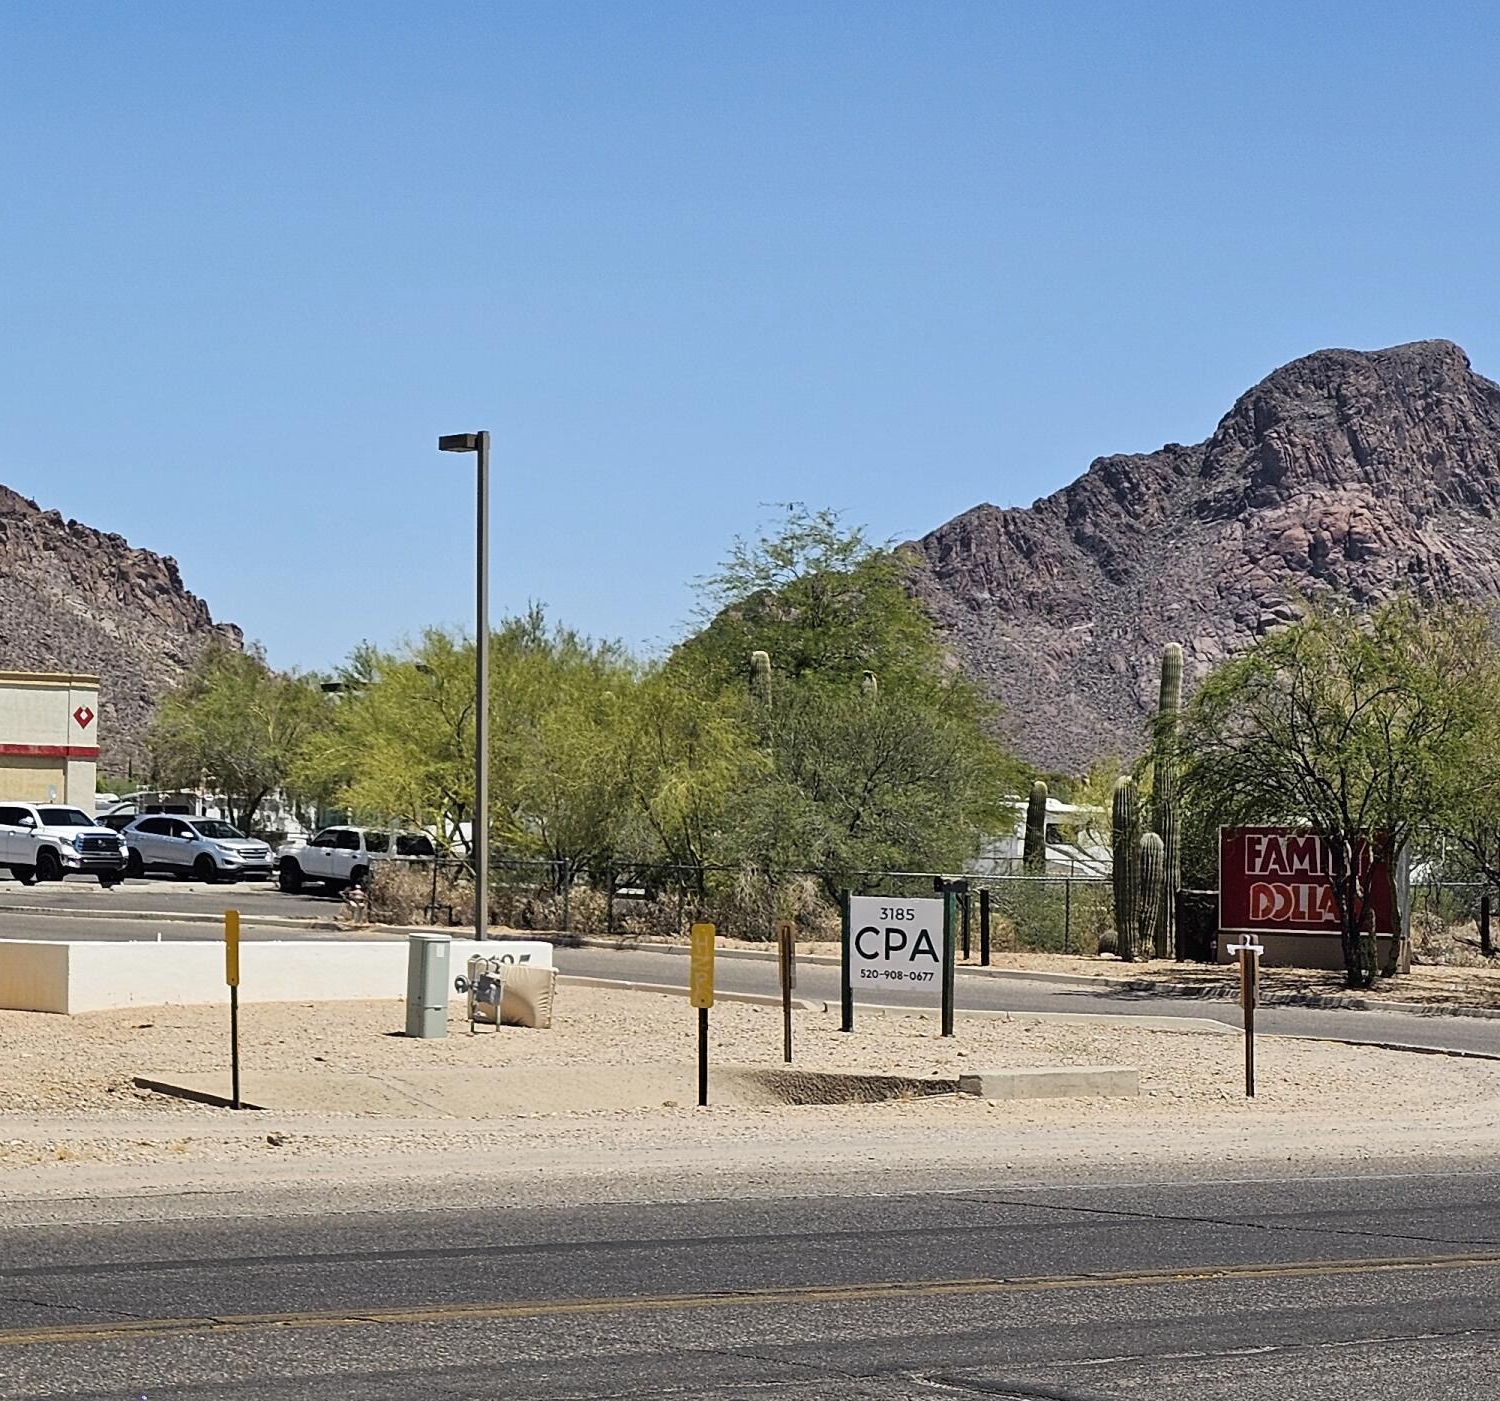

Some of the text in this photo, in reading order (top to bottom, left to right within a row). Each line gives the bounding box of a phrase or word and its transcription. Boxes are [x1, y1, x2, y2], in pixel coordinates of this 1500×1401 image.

[1244, 835, 1367, 876] FAMIY
[879, 907, 915, 921] 3185
[1249, 882, 1362, 923] DOLLA
[854, 926, 940, 963] CPA
[860, 968, 934, 981] 520-908-0677
